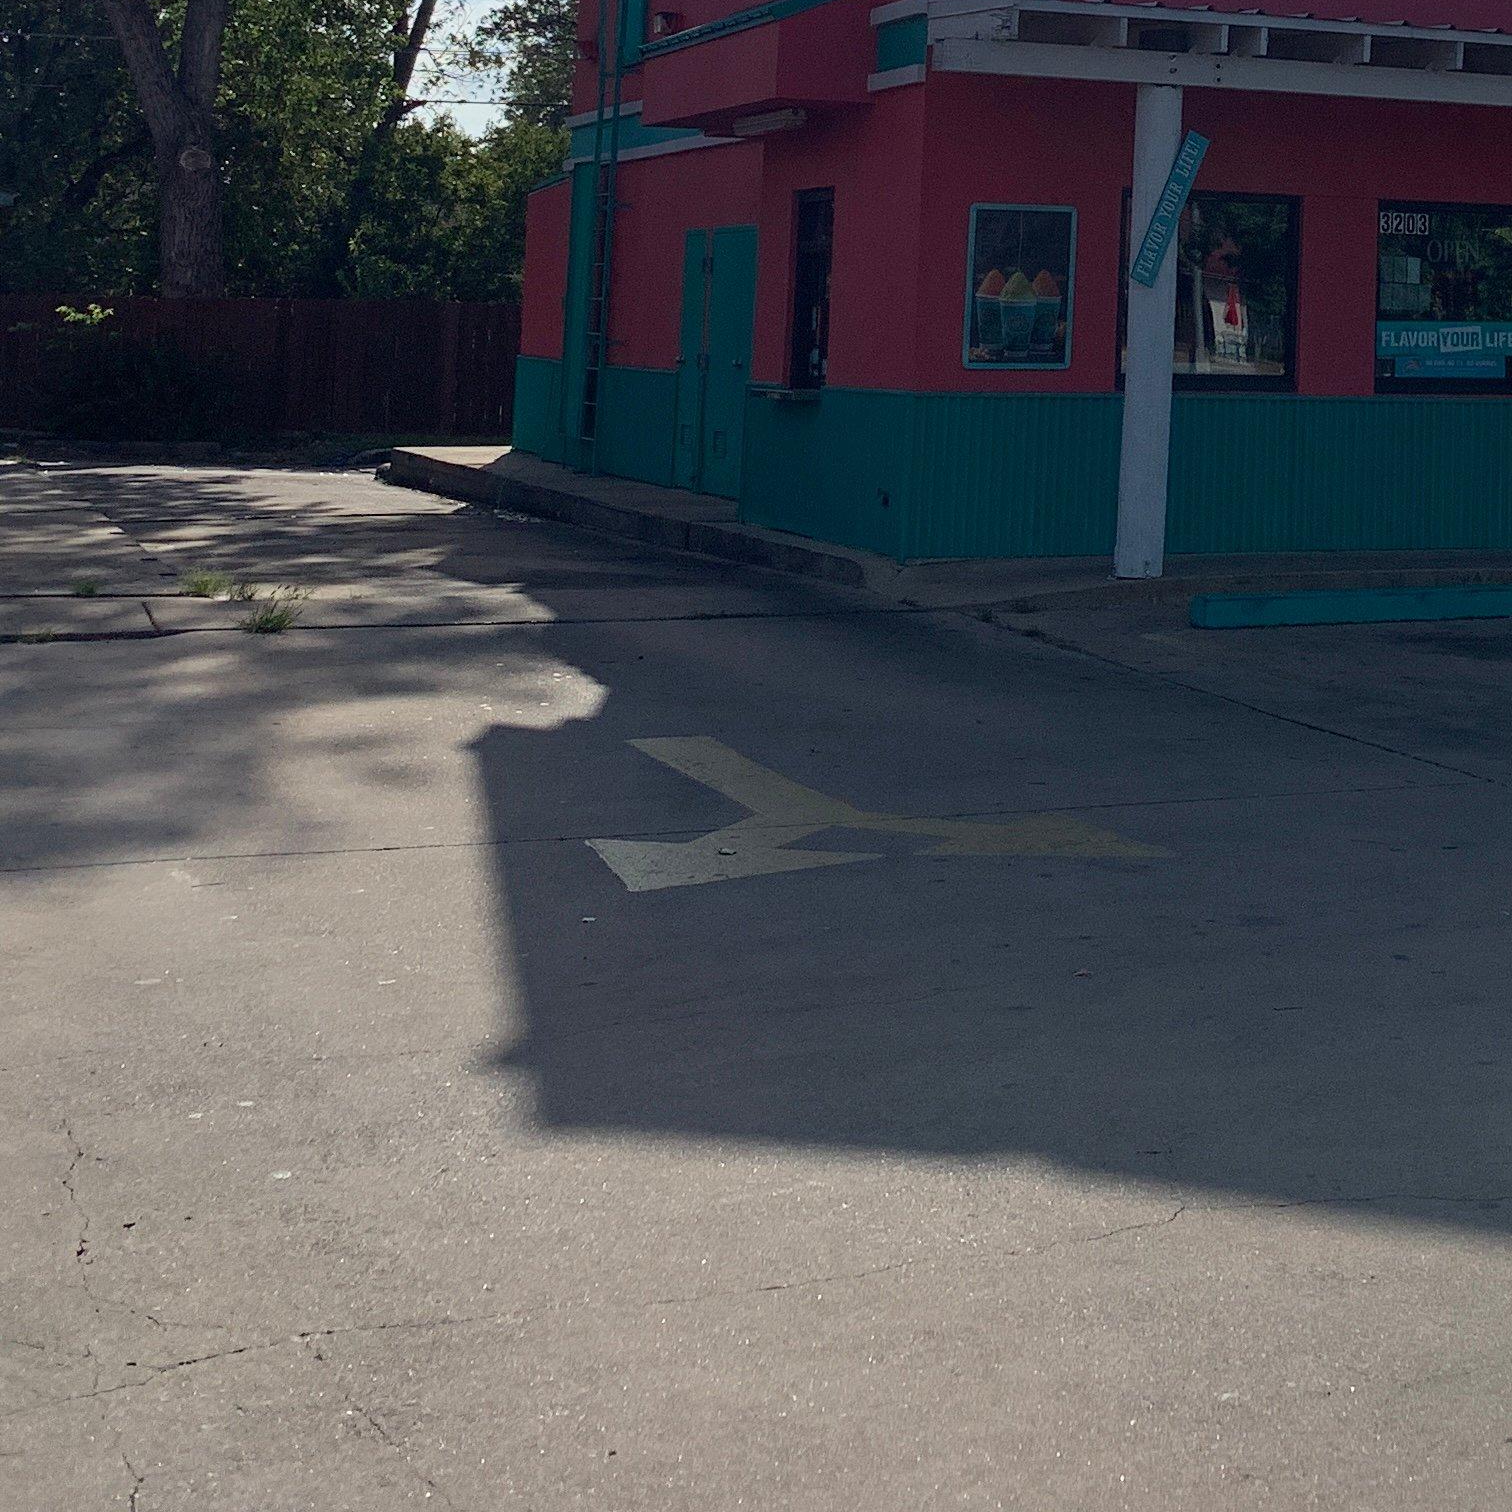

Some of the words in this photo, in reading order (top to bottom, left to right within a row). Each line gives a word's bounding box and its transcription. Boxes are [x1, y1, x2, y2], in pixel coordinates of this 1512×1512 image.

[1135, 221, 1168, 277] FLAVOR
[1159, 180, 1183, 224] YOUR
[1380, 212, 1429, 235] 3203
[1426, 239, 1480, 263] OPEN
[1381, 331, 1437, 348] FLAVOR
[1440, 329, 1481, 348] YOUR
